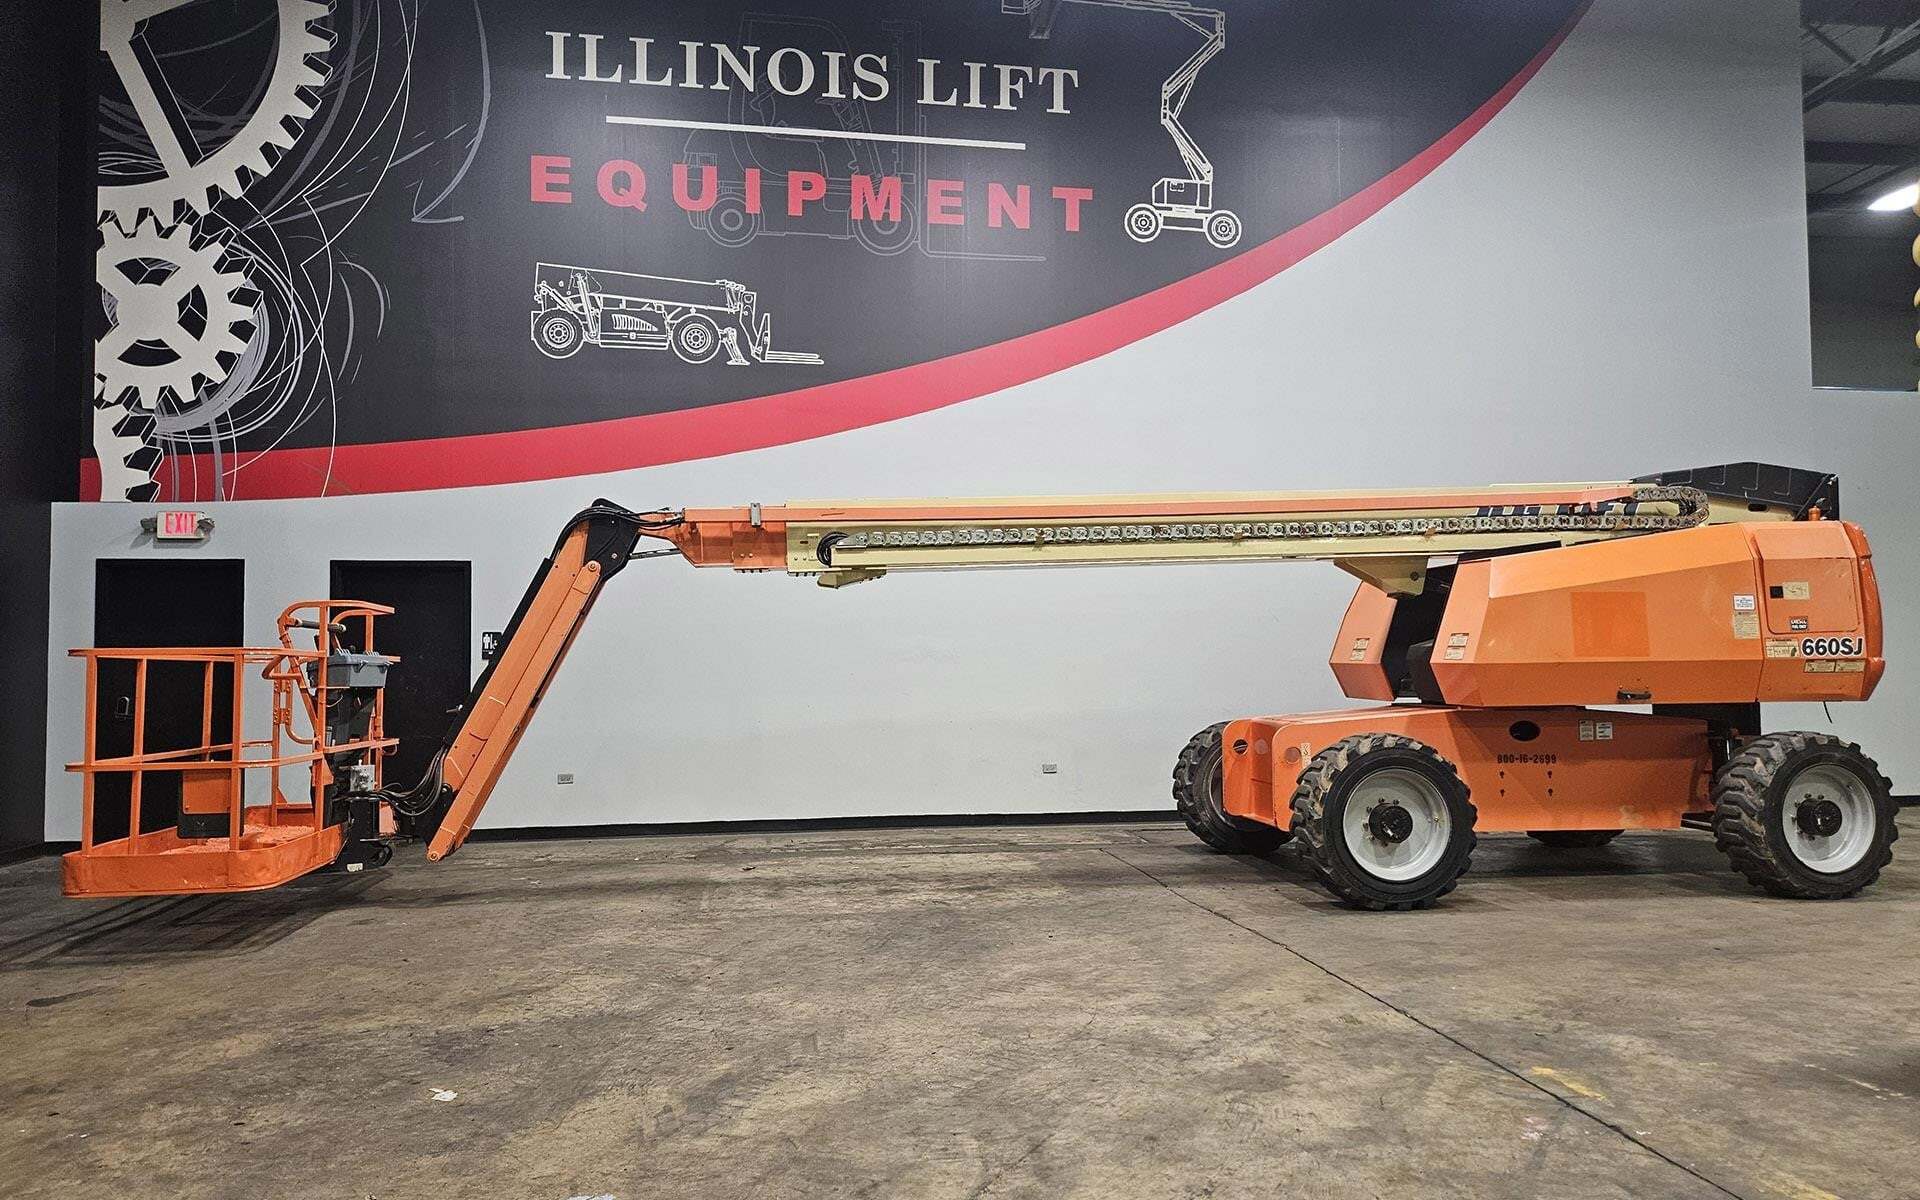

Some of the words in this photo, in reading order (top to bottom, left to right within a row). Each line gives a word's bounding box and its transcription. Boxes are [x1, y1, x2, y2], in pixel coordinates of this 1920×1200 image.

[545, 31, 889, 102] ILLINOIS
[917, 58, 1079, 114] LIFT
[530, 155, 1093, 232] EQUIPMENT
[165, 512, 197, 534] EXIT
[1801, 637, 1863, 656] 660SJ
